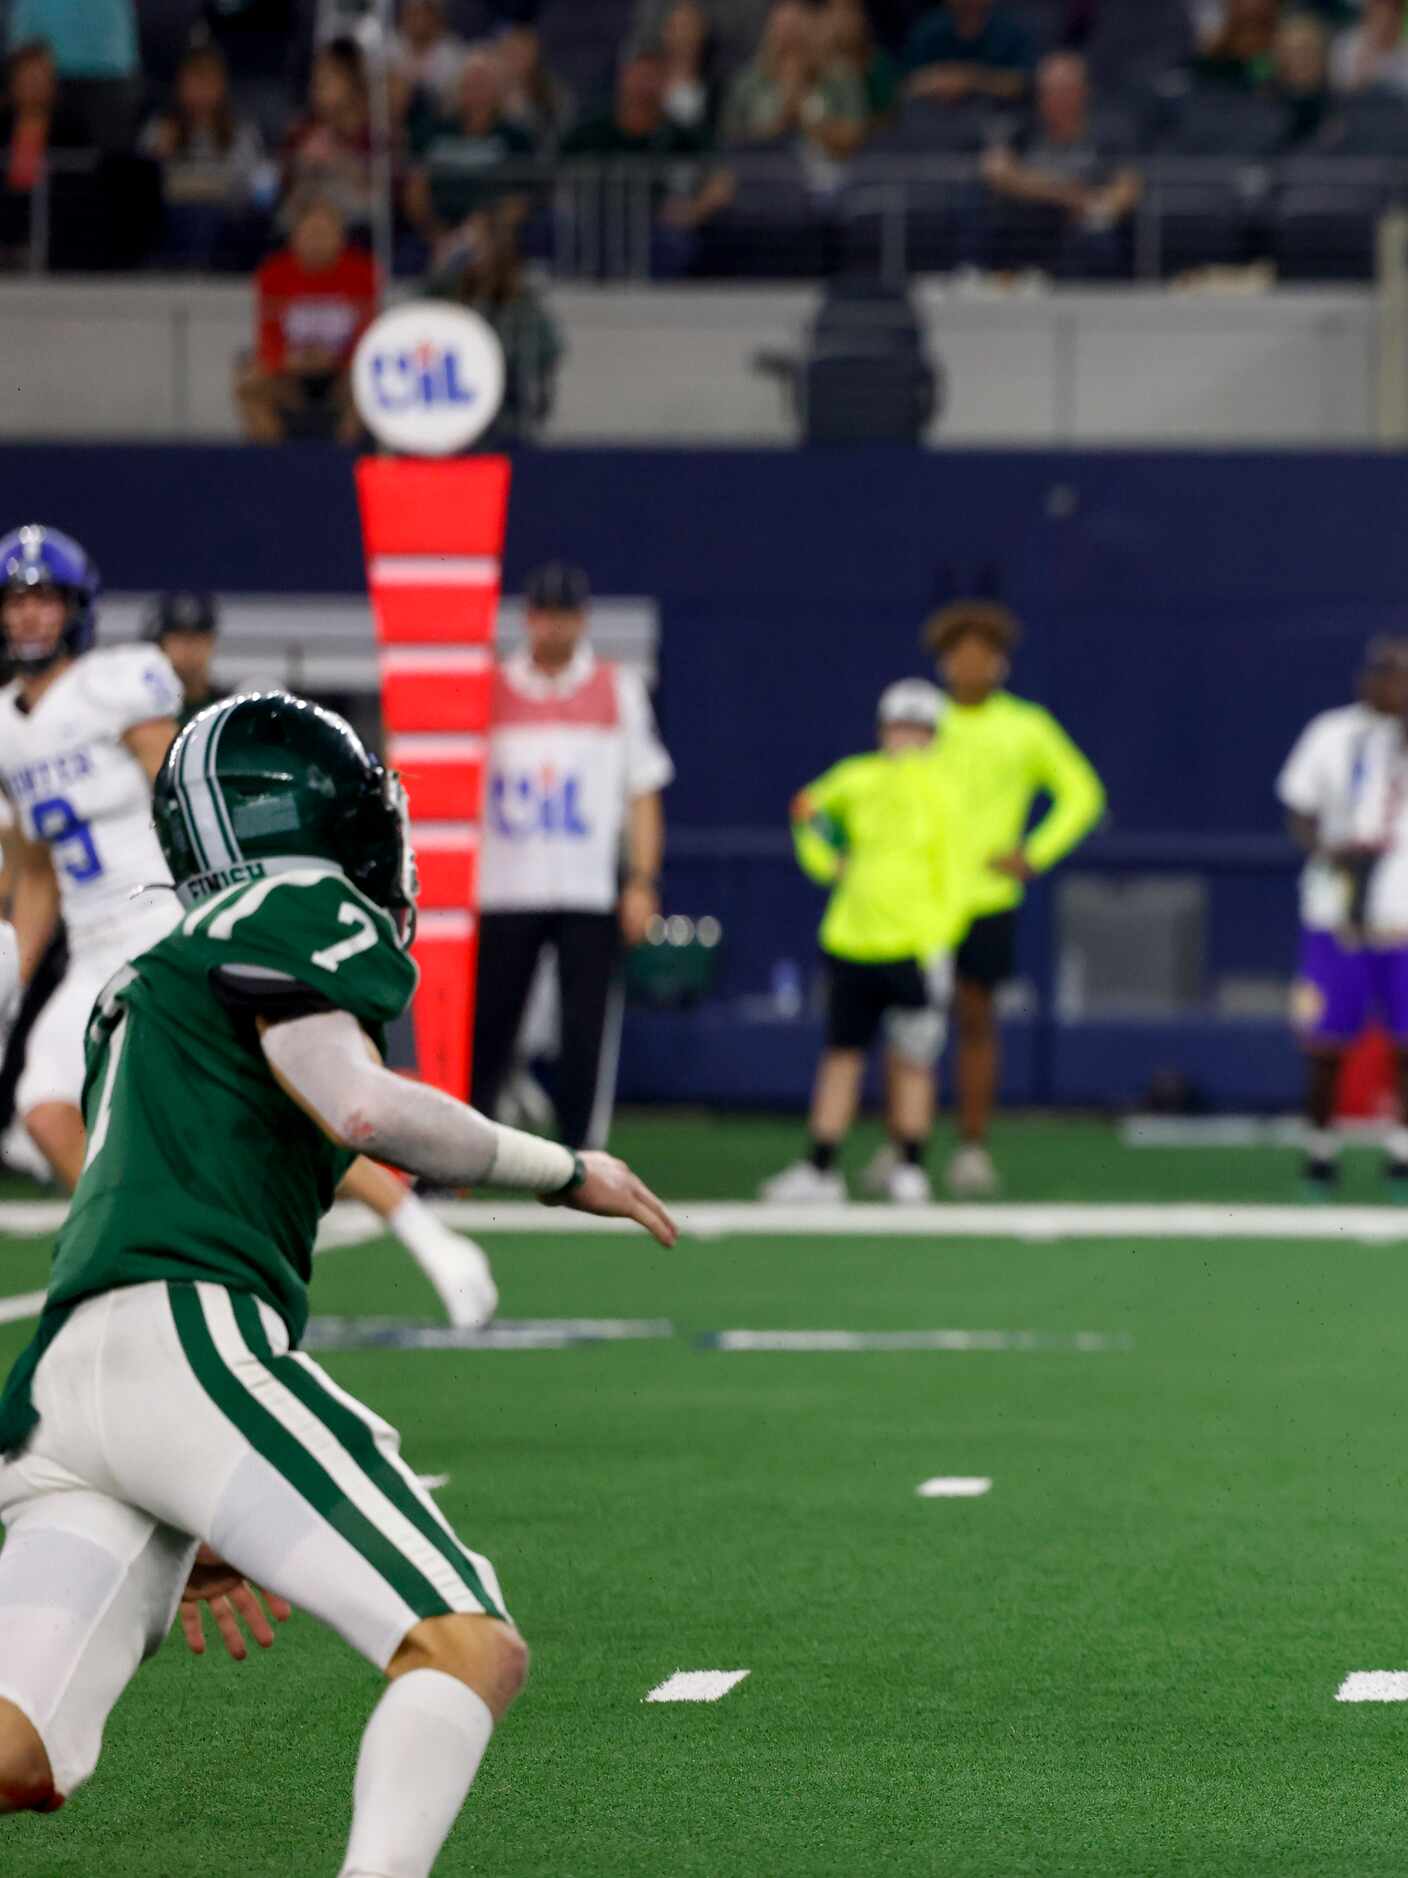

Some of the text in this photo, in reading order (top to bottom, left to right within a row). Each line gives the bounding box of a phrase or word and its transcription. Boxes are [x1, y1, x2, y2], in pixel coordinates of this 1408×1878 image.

[32, 796, 104, 884] 9
[187, 861, 266, 900] FINISH
[310, 900, 379, 973] 7
